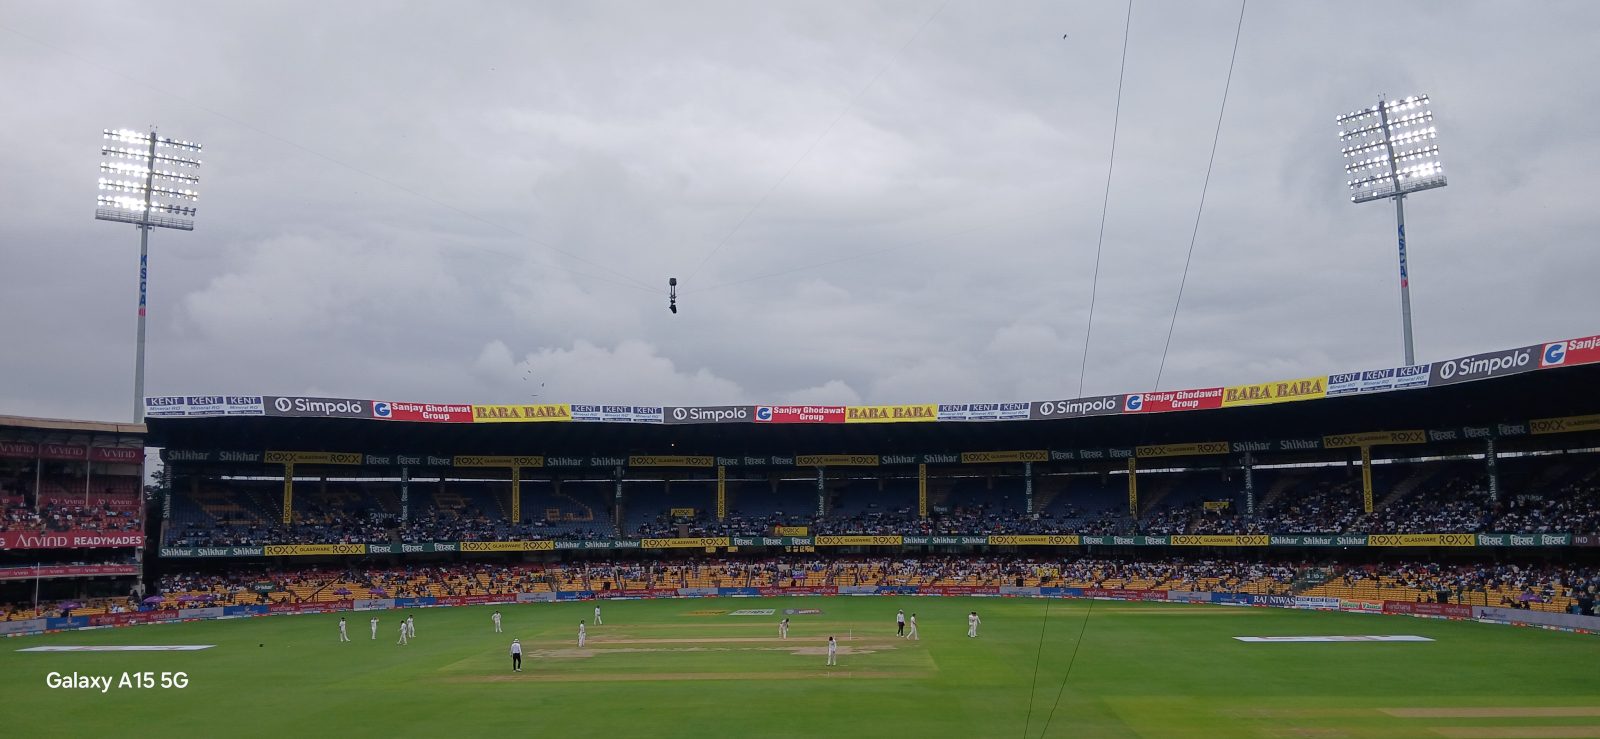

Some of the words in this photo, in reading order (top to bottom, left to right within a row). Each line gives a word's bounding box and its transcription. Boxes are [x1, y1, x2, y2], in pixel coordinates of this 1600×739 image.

[1398, 224, 1407, 278] KSCA
[1460, 352, 1530, 375] Simpolo
[1366, 370, 1390, 380] KENT
[1400, 365, 1424, 376] KENT
[1333, 373, 1356, 383] KENT
[1144, 393, 1174, 402] Sanjay
[1176, 390, 1222, 400] Ghodawat
[1226, 385, 1272, 402] BABA
[1276, 380, 1322, 397] BABA
[151, 398, 179, 406] KENT
[192, 397, 218, 405] KENT
[1057, 398, 1116, 414] Simpolo
[1171, 400, 1198, 408] Group
[295, 398, 361, 415] Simpolo
[392, 403, 423, 413] Sanjay
[425, 404, 471, 412] Ghodawat
[774, 406, 801, 414] Sanjay
[803, 406, 845, 414] Ghodawat
[422, 412, 449, 420] Group
[476, 407, 521, 418] BABA
[523, 406, 569, 418] BABA
[690, 408, 746, 422] Simpolo
[800, 413, 824, 421] Group
[847, 408, 889, 419] BABA
[892, 407, 935, 418] BABA
[1531, 420, 1567, 431] ROXX
[1326, 437, 1358, 446] ROXX
[1390, 432, 1423, 442] ROXX
[1138, 447, 1166, 456] ROXX
[1197, 444, 1226, 453] ROXX
[1233, 442, 1270, 452] Shikhar
[1280, 440, 1319, 450] Shikhar
[168, 451, 209, 461] Shikhar
[219, 452, 259, 461] Shikhar
[266, 453, 296, 461] ROXX
[330, 455, 358, 463] ROXX
[455, 457, 484, 465] ROXX
[514, 457, 541, 465] ROXX
[630, 457, 657, 465] ROXX
[686, 457, 712, 465] ROXX
[851, 456, 876, 464] ROXX
[882, 455, 915, 464] Shikhar
[924, 455, 957, 463] Shikhar
[963, 453, 990, 461] ROXX
[1019, 452, 1046, 460] ROXX
[547, 457, 582, 466] Shikhar
[591, 457, 625, 466] Shikhar
[74, 536, 142, 546] READYMADES
[734, 537, 753, 546] शिखर
[762, 537, 782, 546] शिखर
[791, 537, 811, 545] शिखर
[903, 536, 928, 544] Shikhar
[932, 536, 957, 544] Shikhar
[961, 536, 986, 544] Shikhar
[990, 536, 1018, 544] ROXX
[1049, 536, 1076, 544] ROXX
[1083, 536, 1103, 545] शिखर
[1113, 536, 1134, 545] शिखर
[1144, 536, 1166, 545] शिखर
[1172, 536, 1202, 544] ROXX
[1236, 536, 1266, 544] ROXX
[1270, 536, 1297, 545] Shikhar
[1303, 536, 1331, 545] Shikhar
[1337, 536, 1366, 545] Shikhar
[1370, 536, 1402, 545] ROXX
[1439, 535, 1472, 545] ROXX
[1478, 535, 1503, 546] शिखर
[1510, 535, 1534, 546] शिखर
[1541, 534, 1566, 545] शिखर
[1575, 536, 1588, 544] IND
[161, 548, 191, 556] Shikhar
[198, 547, 227, 556] Shikhar
[233, 546, 261, 555] Shikhar
[266, 546, 298, 554] ROXX
[332, 546, 361, 554] ROXX
[369, 544, 391, 553] शिखर
[401, 544, 423, 553] शिखर
[433, 543, 455, 552] शिखर
[523, 542, 551, 550] ROXX
[1253, 595, 1267, 604] RAJ
[1269, 596, 1295, 605] NIWAS
